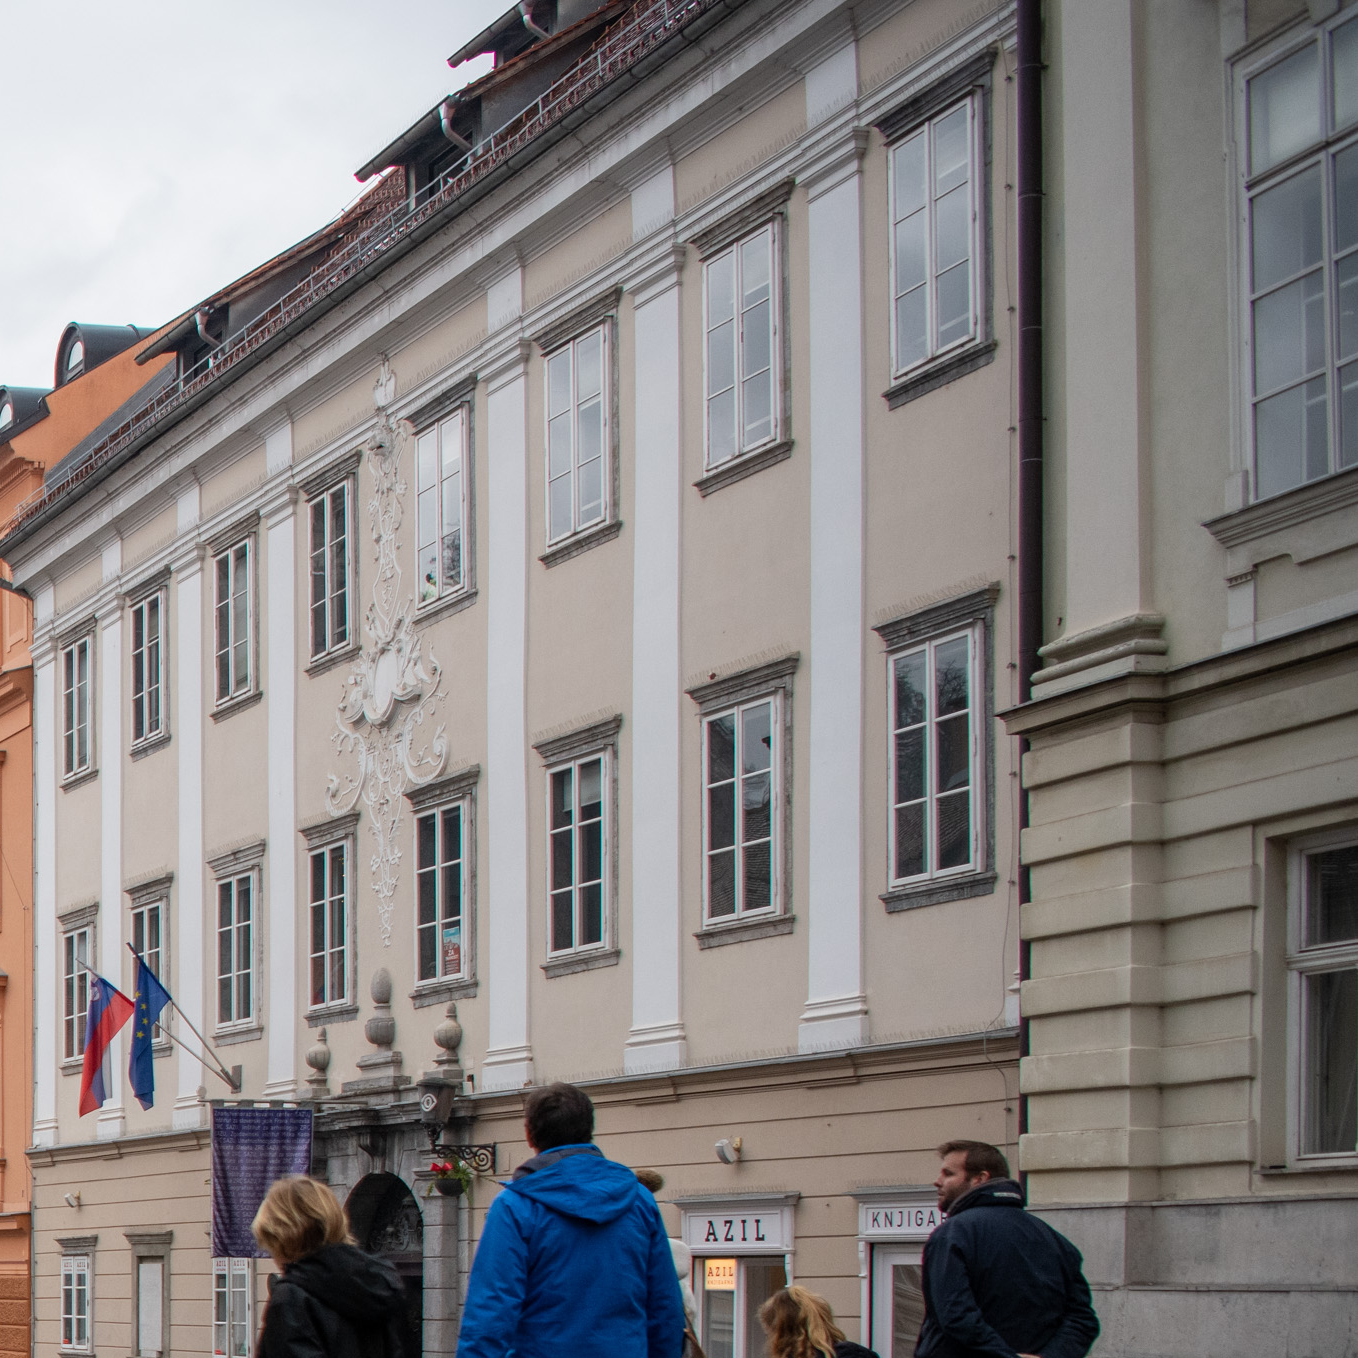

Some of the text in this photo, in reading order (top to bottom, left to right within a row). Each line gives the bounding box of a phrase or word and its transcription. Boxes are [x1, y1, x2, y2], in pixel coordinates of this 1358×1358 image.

[872, 1210, 948, 1228] KNJIGAR
[705, 1219, 765, 1242] AZIL
[707, 1266, 734, 1277] AZIL
